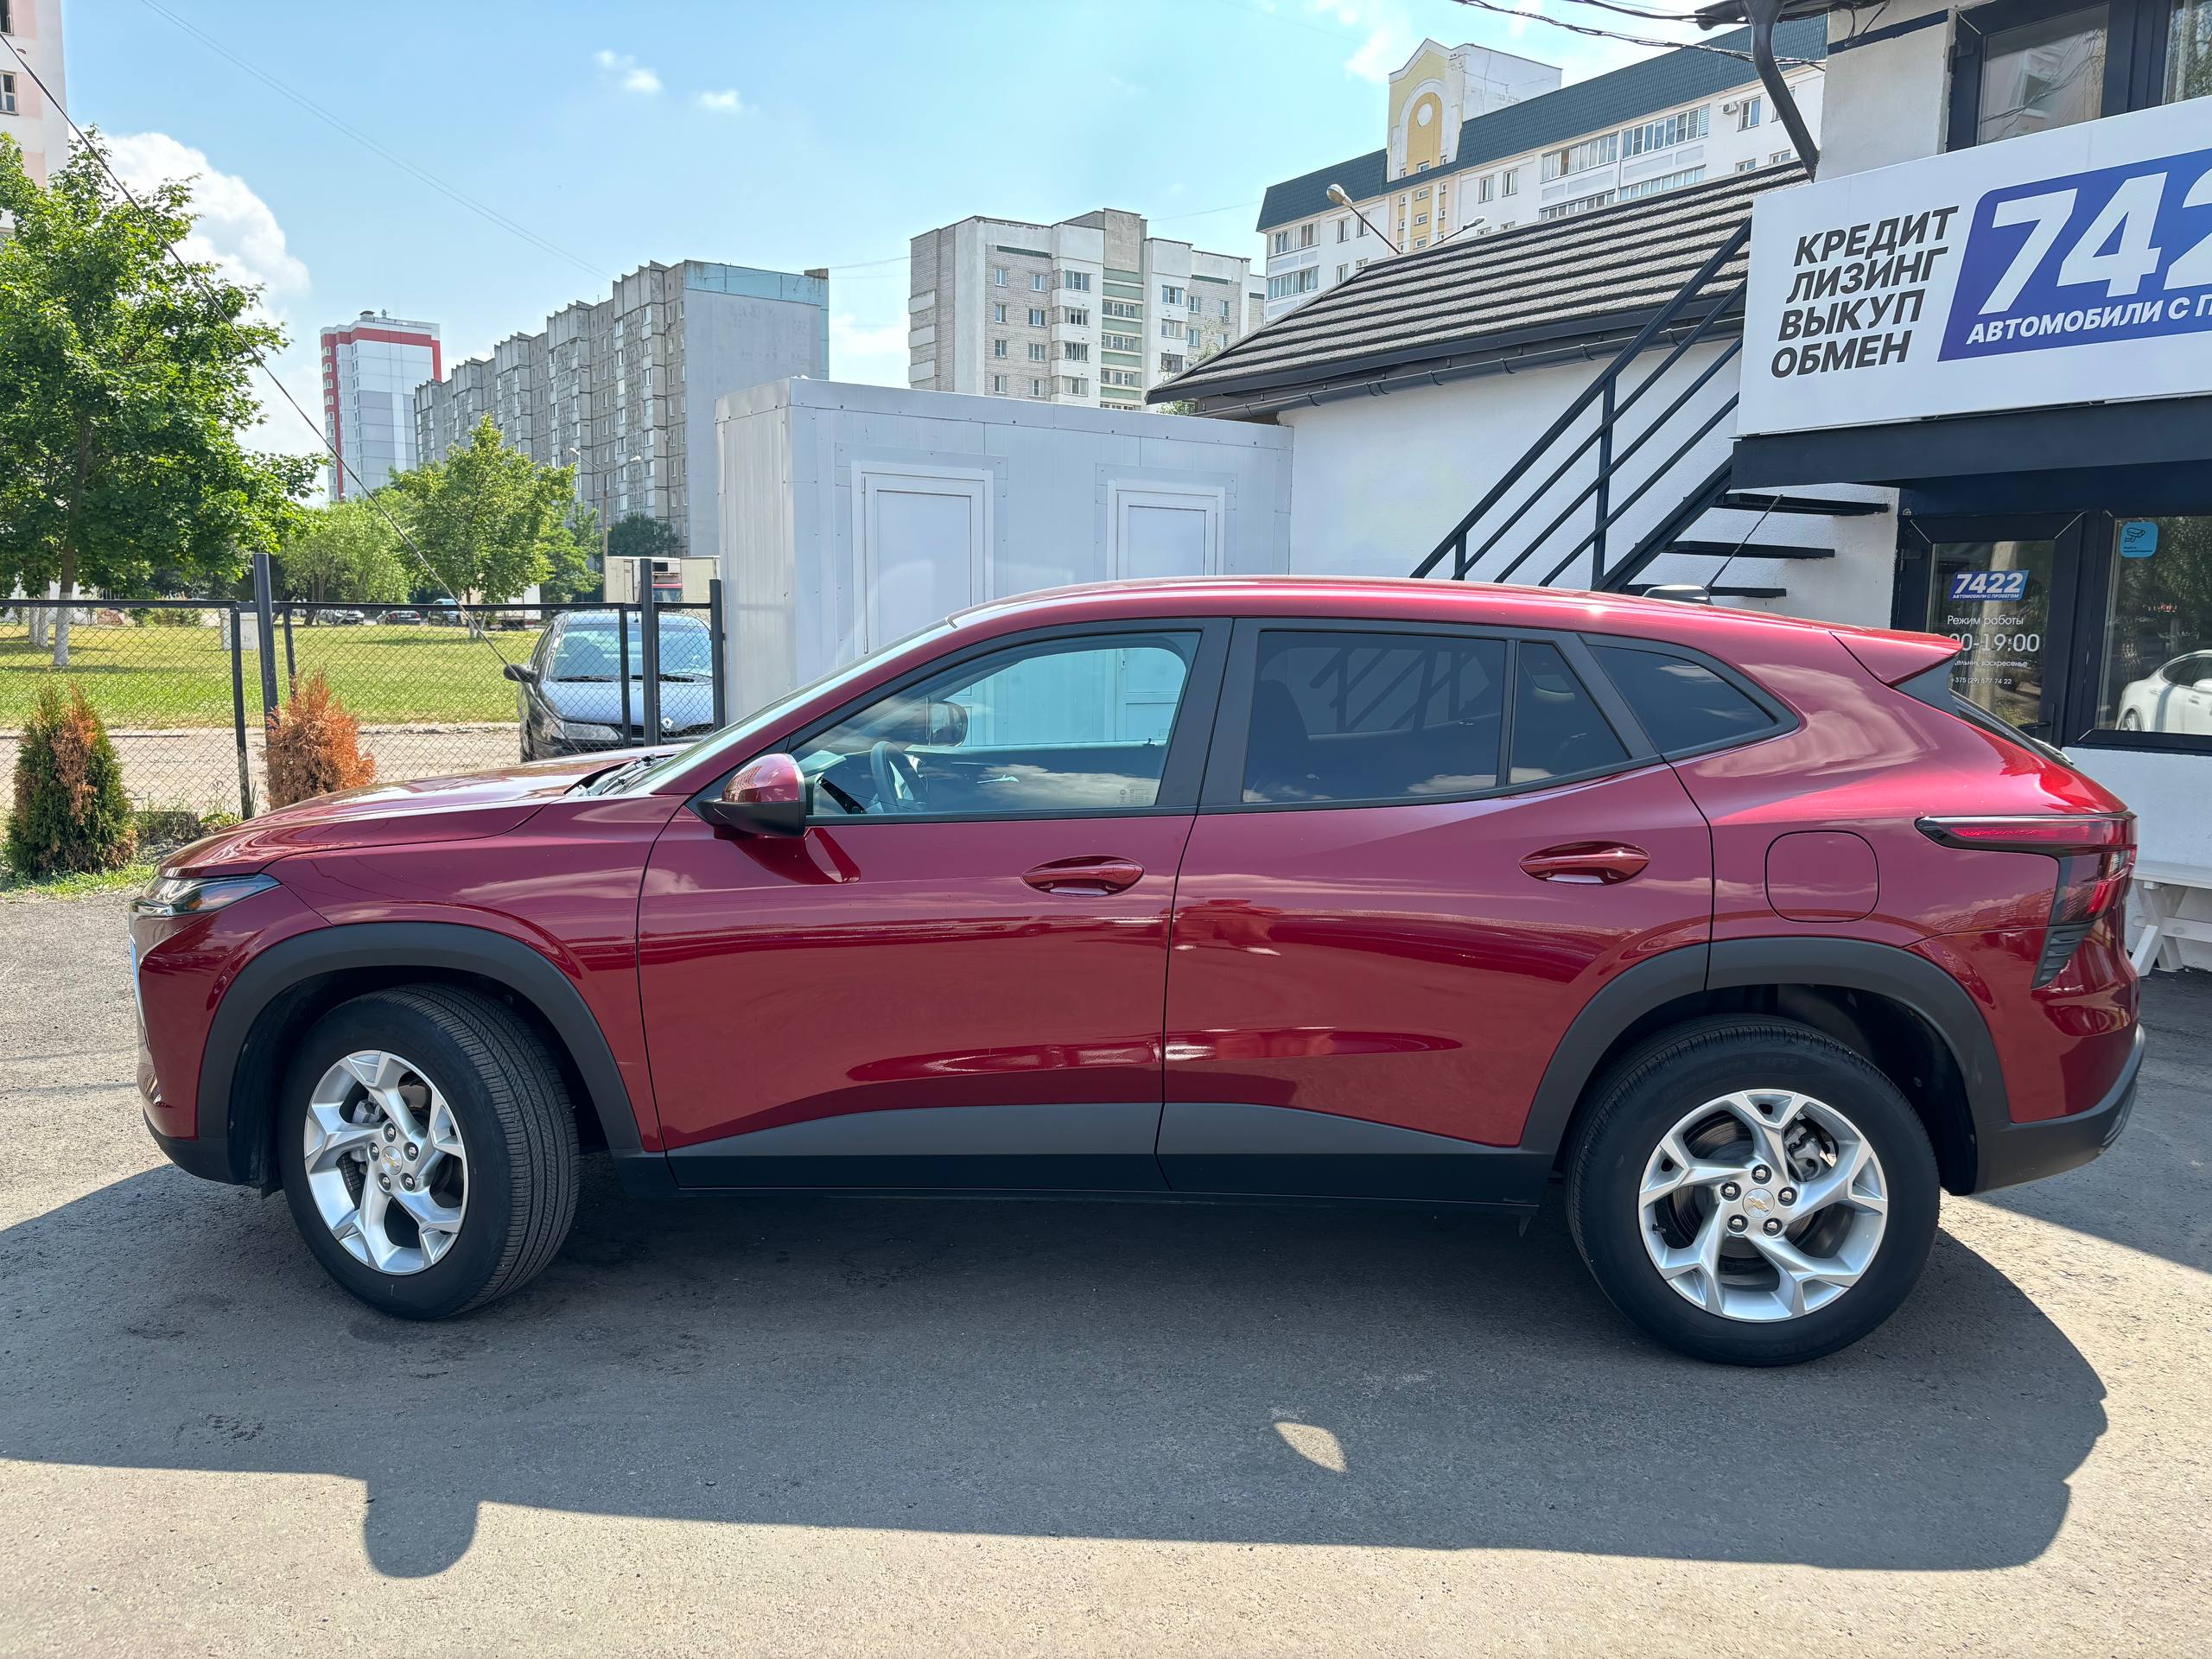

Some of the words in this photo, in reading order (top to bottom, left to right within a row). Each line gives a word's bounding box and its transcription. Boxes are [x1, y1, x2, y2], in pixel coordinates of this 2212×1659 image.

[1793, 206, 1959, 267] КРЕДИТ
[1785, 246, 1948, 304] ЛИЗИНГ
[1777, 289, 1926, 341] ВЫКУП
[1966, 300, 2164, 345] АВТОМОБИЛИ
[2168, 296, 2190, 320] С
[1770, 330, 1912, 378] ОБМЕН
[1955, 573, 2023, 594] 7422
[1947, 614, 1980, 625] Режим
[1984, 614, 2024, 626] работы
